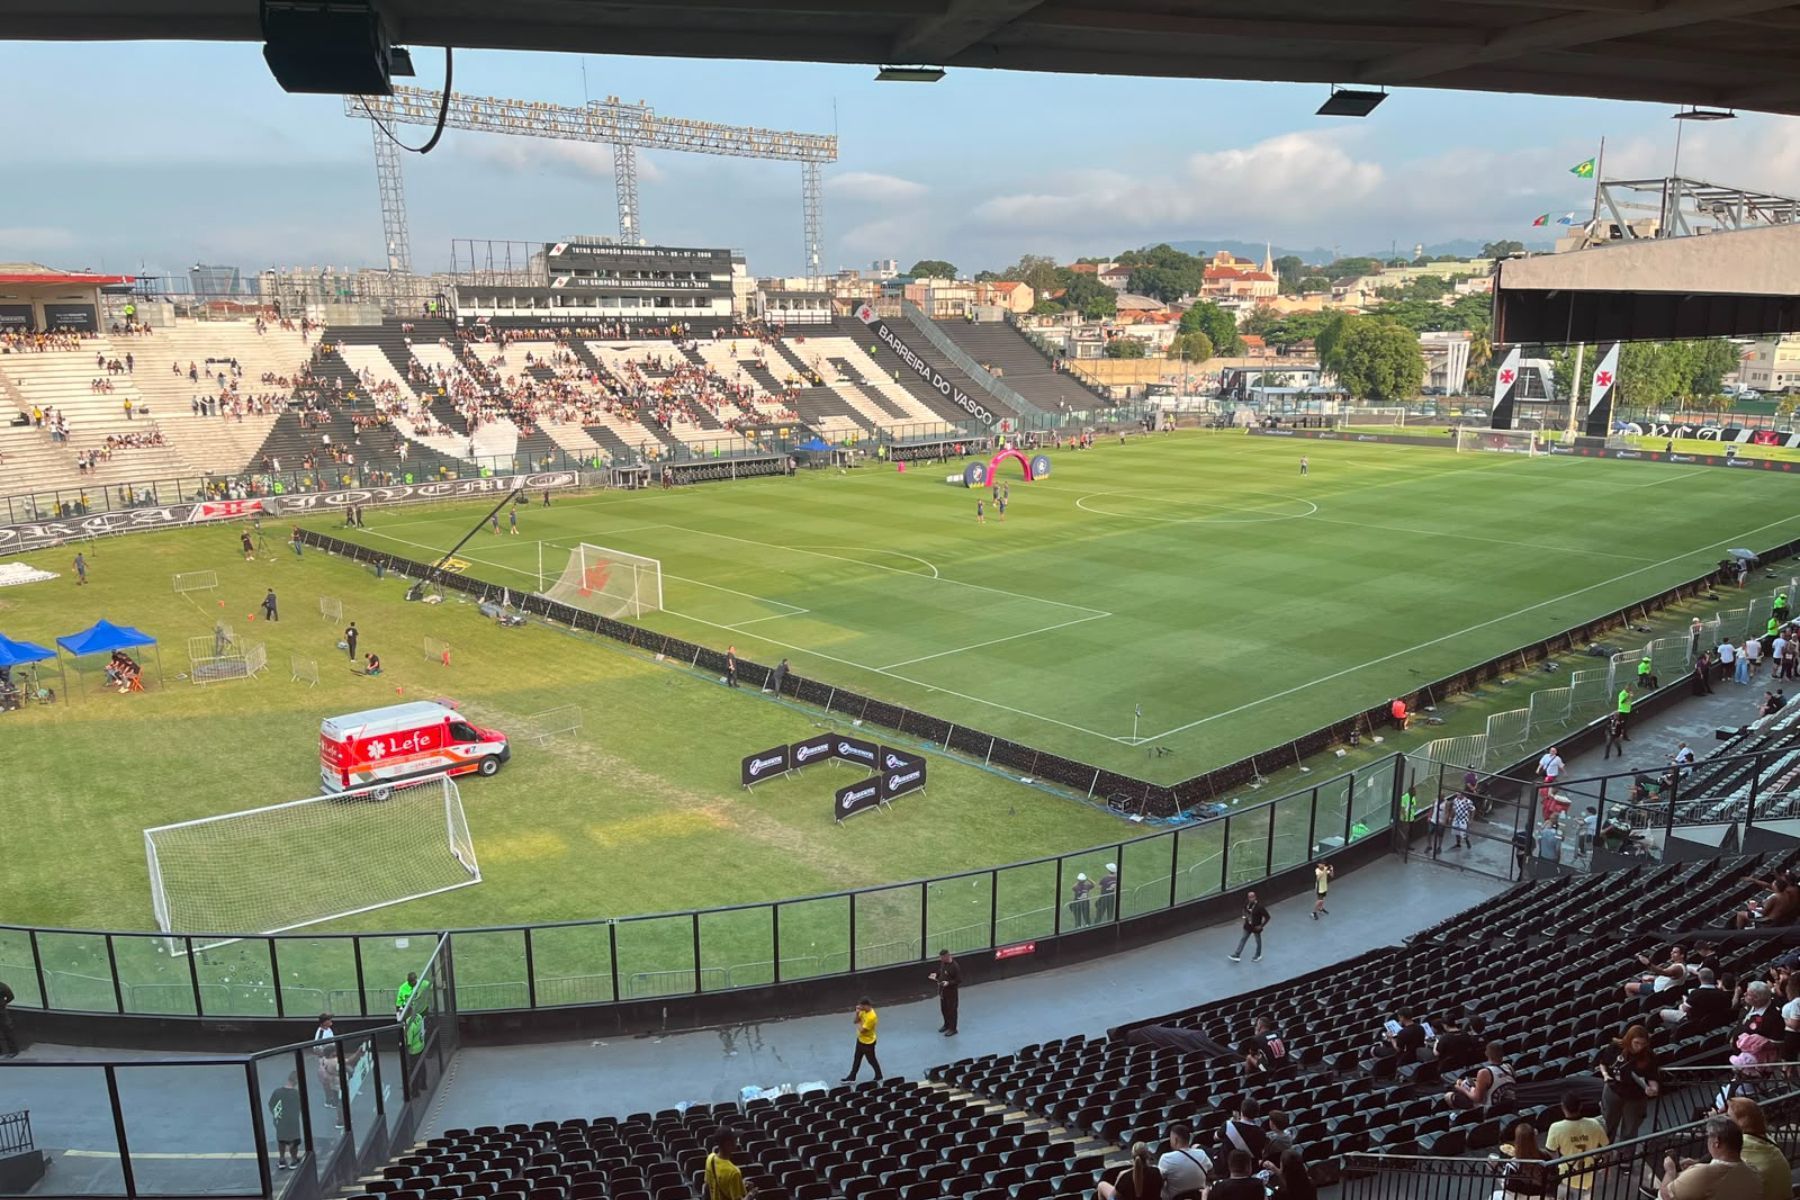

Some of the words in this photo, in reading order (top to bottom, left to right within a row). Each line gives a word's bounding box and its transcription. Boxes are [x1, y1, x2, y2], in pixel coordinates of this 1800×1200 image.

[878, 324, 930, 382] BARREIRA
[932, 373, 950, 395] DO
[954, 387, 992, 425] VASCO
[389, 731, 432, 752] Lefe
